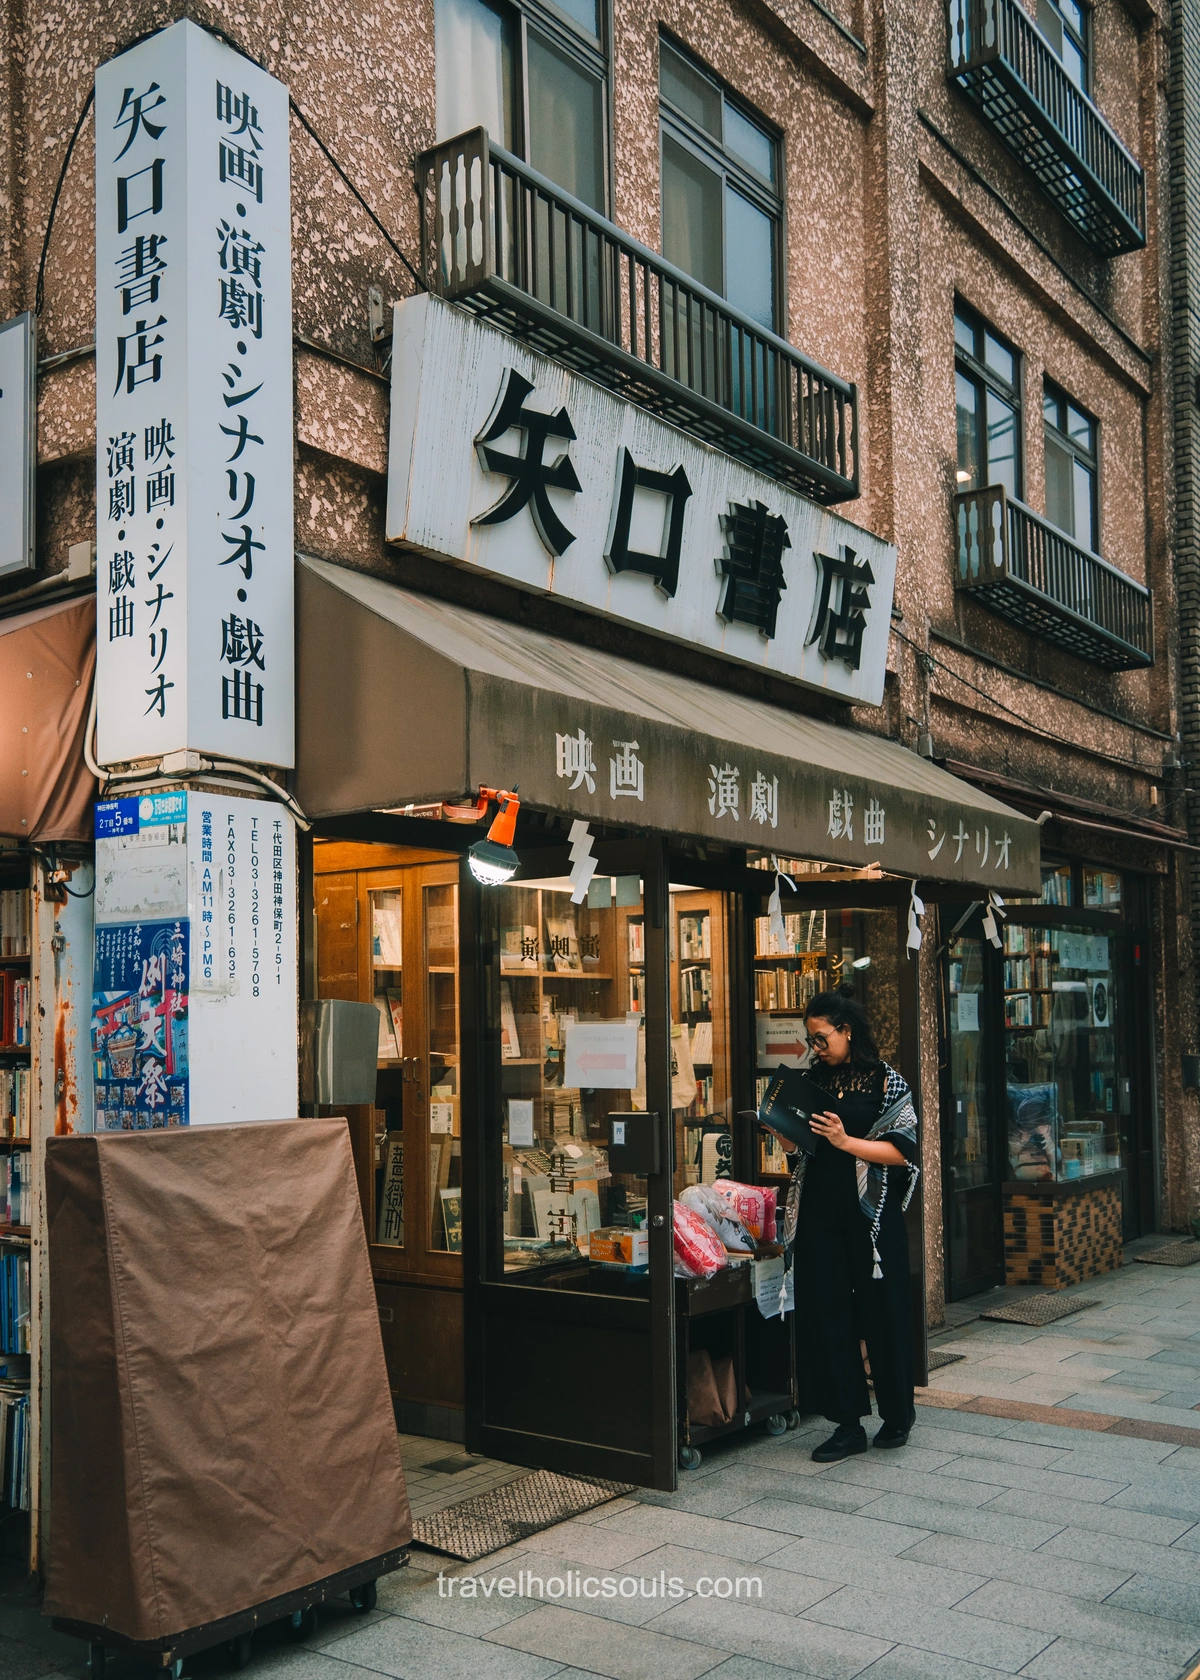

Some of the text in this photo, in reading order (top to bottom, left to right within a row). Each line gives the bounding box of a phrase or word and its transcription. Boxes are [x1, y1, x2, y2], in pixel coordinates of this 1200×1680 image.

[112, 81, 168, 399] 矢口書店
[106, 430, 137, 643] 演劇・戯曲
[215, 78, 267, 728] 映画・演劇・シナリオ・戯曲
[471, 367, 876, 671] 矢口書店
[143, 417, 176, 719] 映画・シナリオ
[201, 811, 213, 863] 営業時間
[555, 727, 1012, 870] 映画 演劇 戯曲 シナリオ
